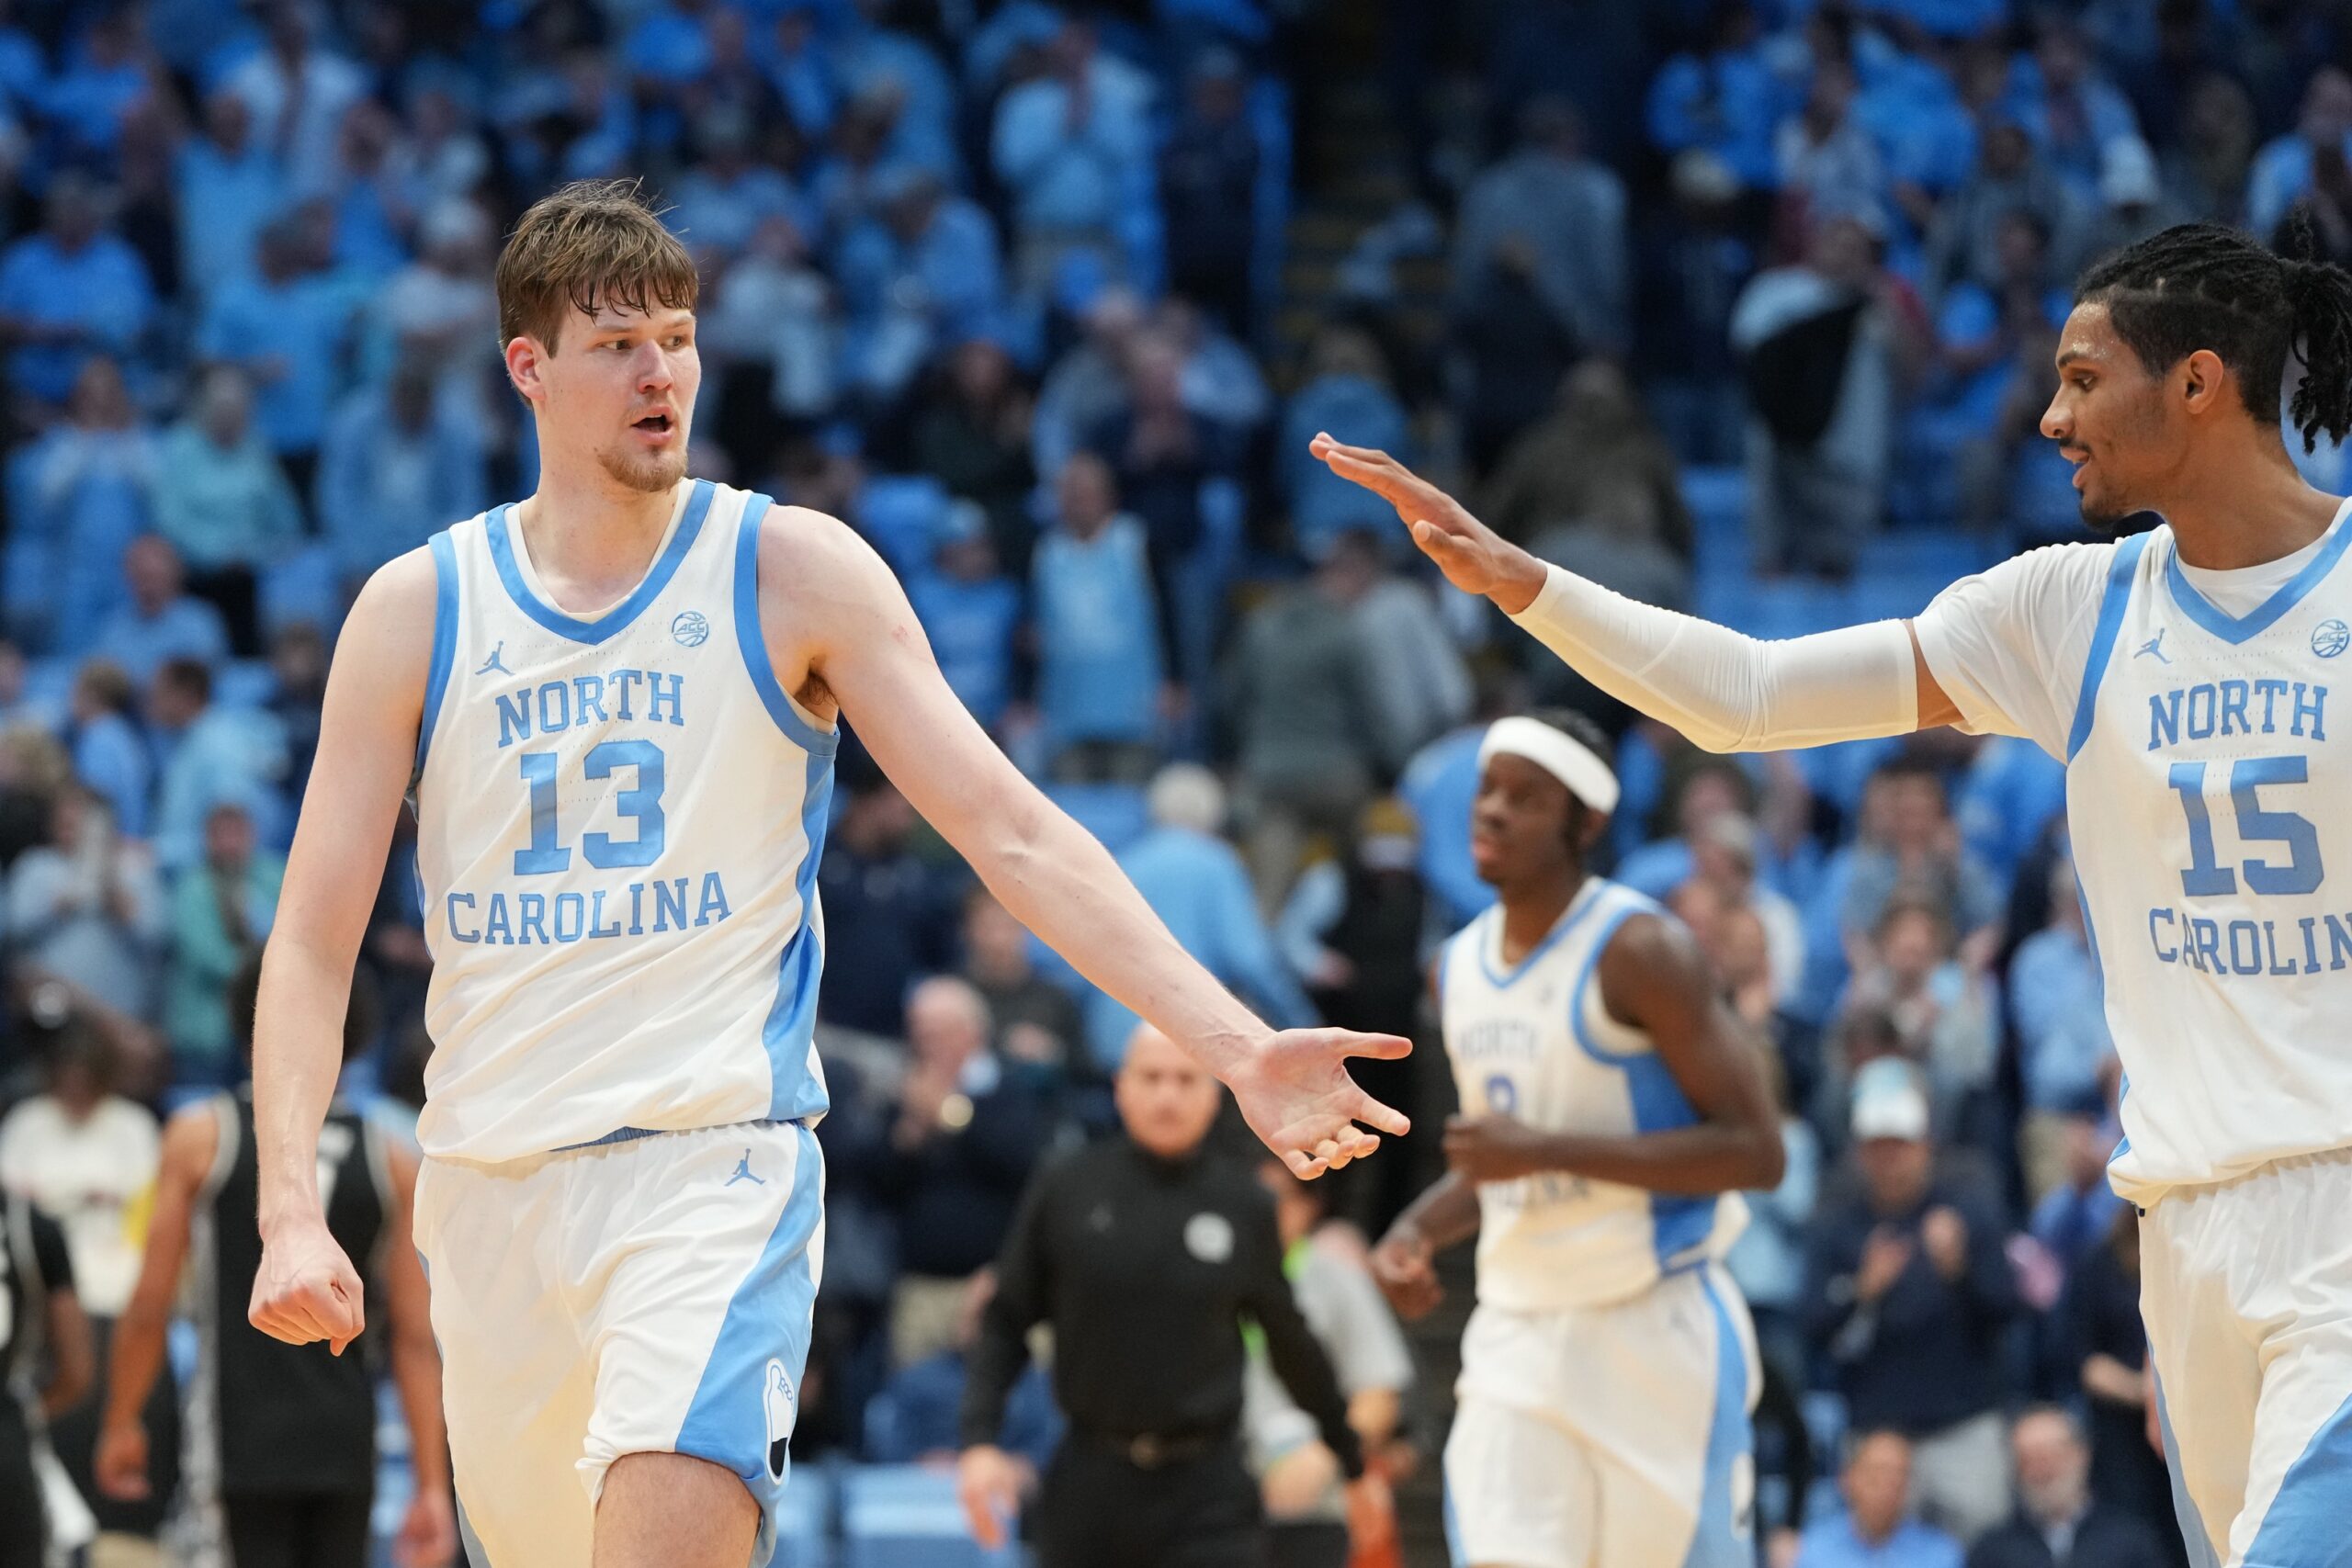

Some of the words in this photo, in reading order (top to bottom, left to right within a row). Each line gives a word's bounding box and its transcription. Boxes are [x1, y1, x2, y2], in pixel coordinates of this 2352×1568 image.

[494, 669, 684, 748] NORTH
[2147, 679, 2328, 751] NORTH
[514, 739, 665, 875] 13
[2168, 755, 2324, 897] 15
[447, 872, 732, 944] CAROLINA
